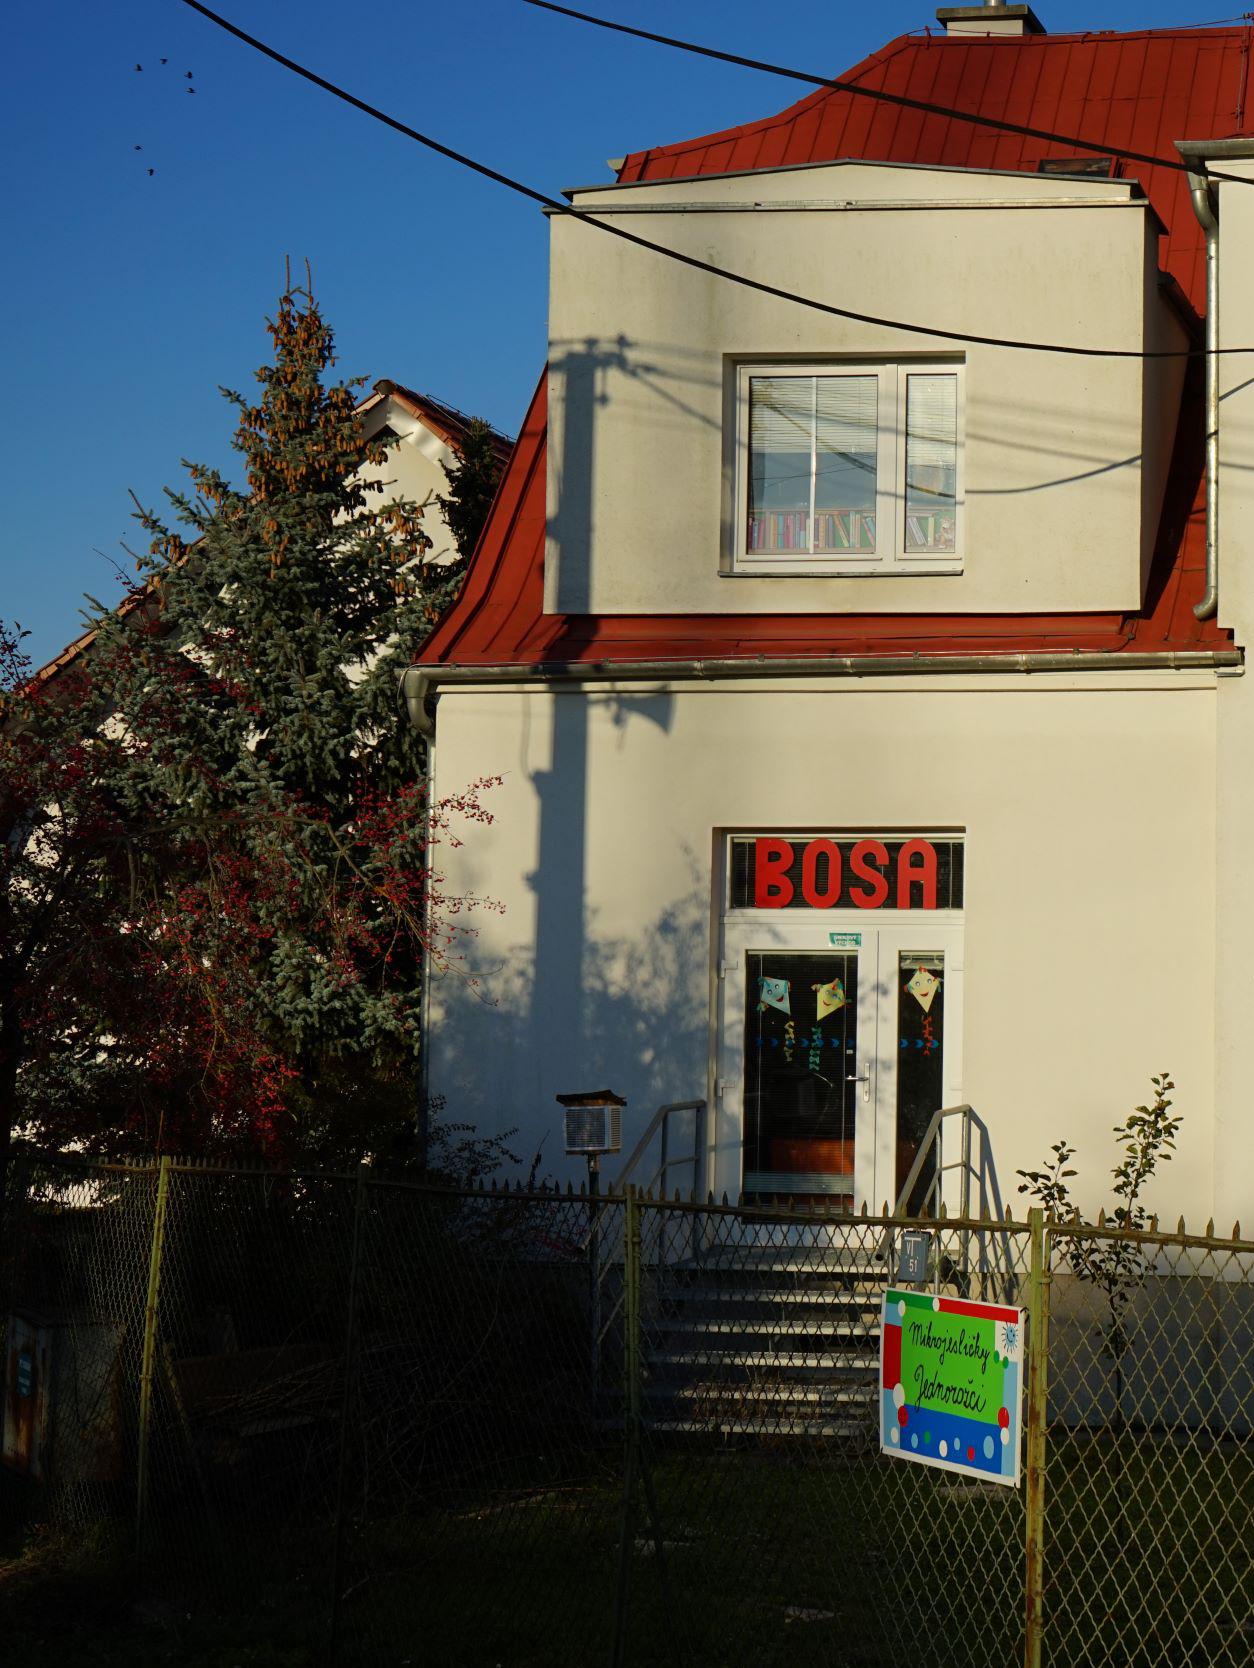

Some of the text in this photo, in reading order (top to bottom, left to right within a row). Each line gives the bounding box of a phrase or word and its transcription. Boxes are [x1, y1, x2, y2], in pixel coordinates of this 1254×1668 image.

[754, 838, 938, 910] BOSA
[909, 1320, 991, 1376] Mikrojesličky
[913, 1363, 987, 1415] Jednorožci
